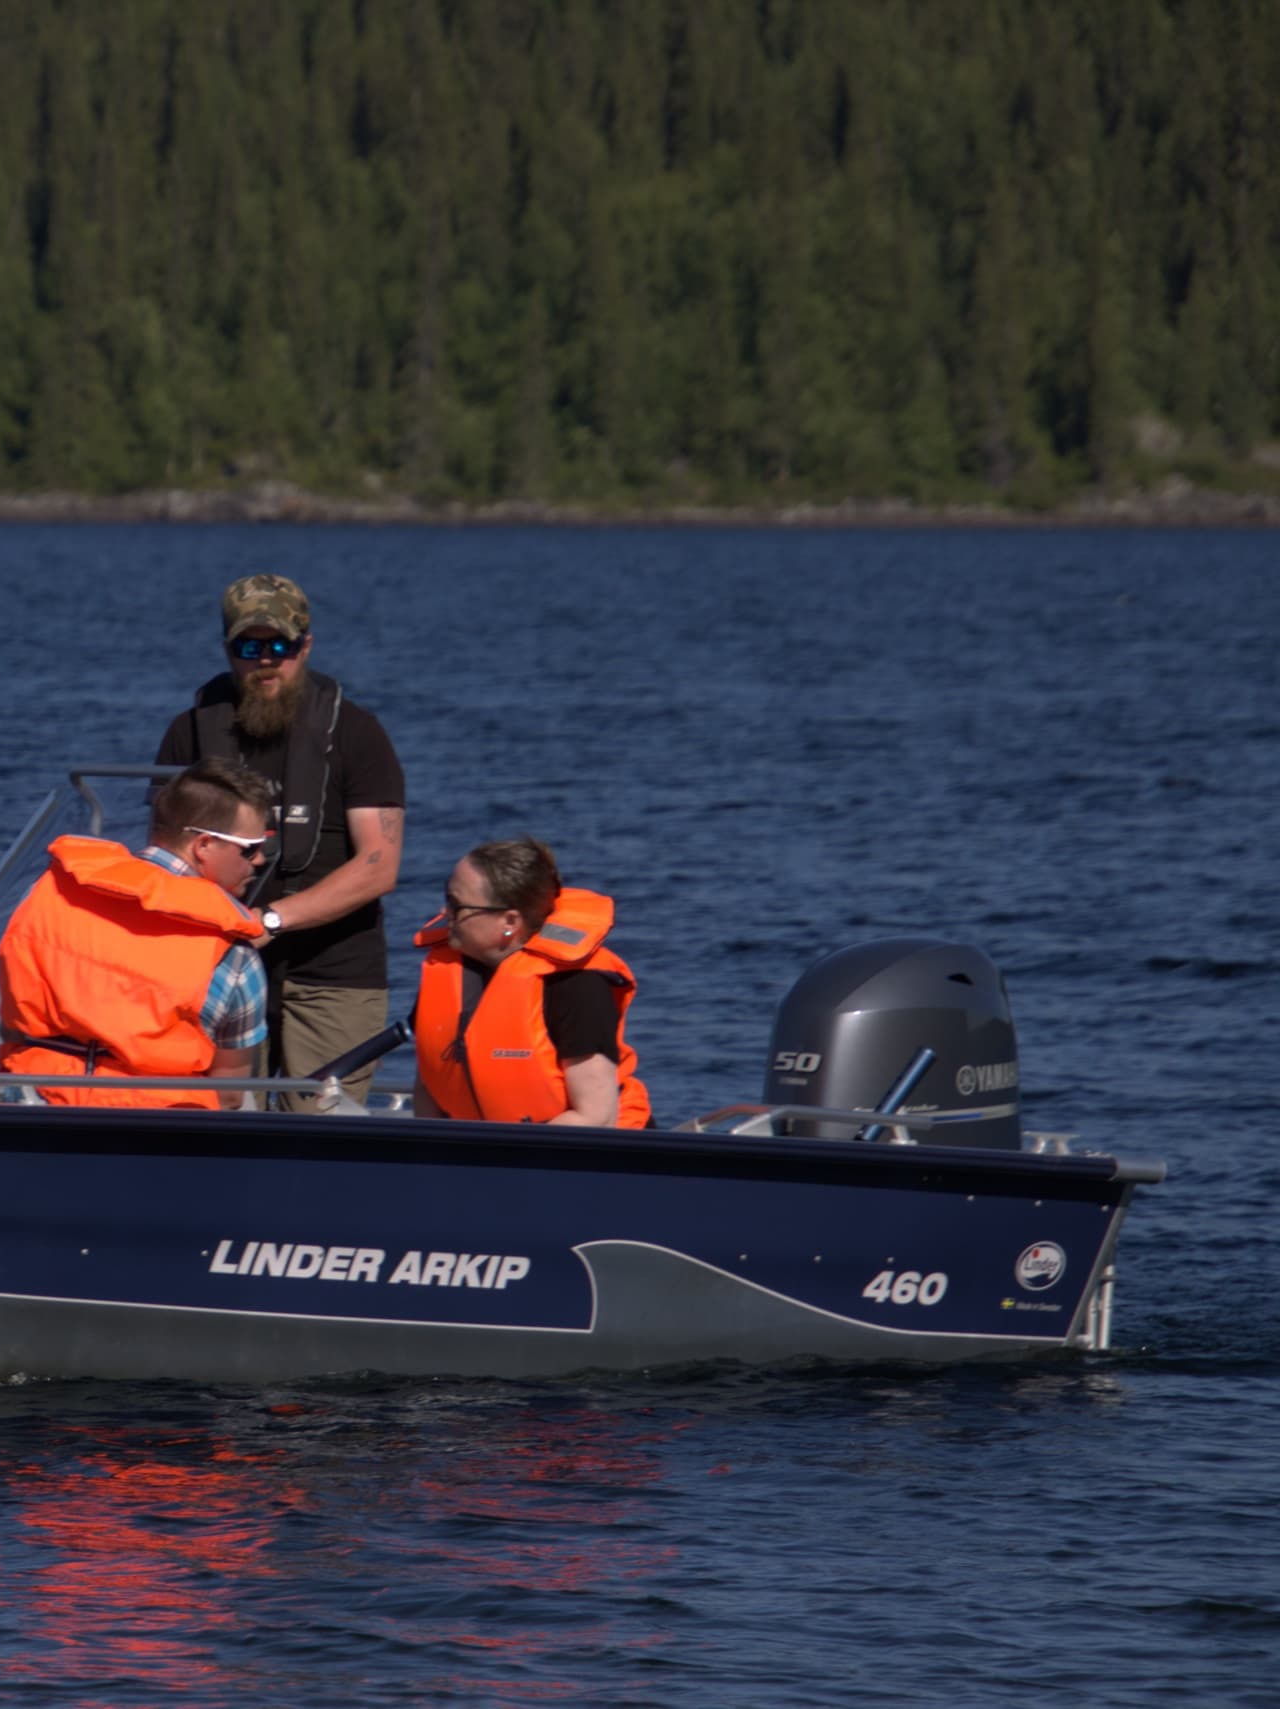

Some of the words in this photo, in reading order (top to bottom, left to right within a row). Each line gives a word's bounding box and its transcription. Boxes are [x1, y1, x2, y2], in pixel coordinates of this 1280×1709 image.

[773, 1052, 822, 1073] 50
[209, 1240, 386, 1283] LINDER
[388, 1250, 531, 1289] ARKIP
[862, 1271, 949, 1306] 460
